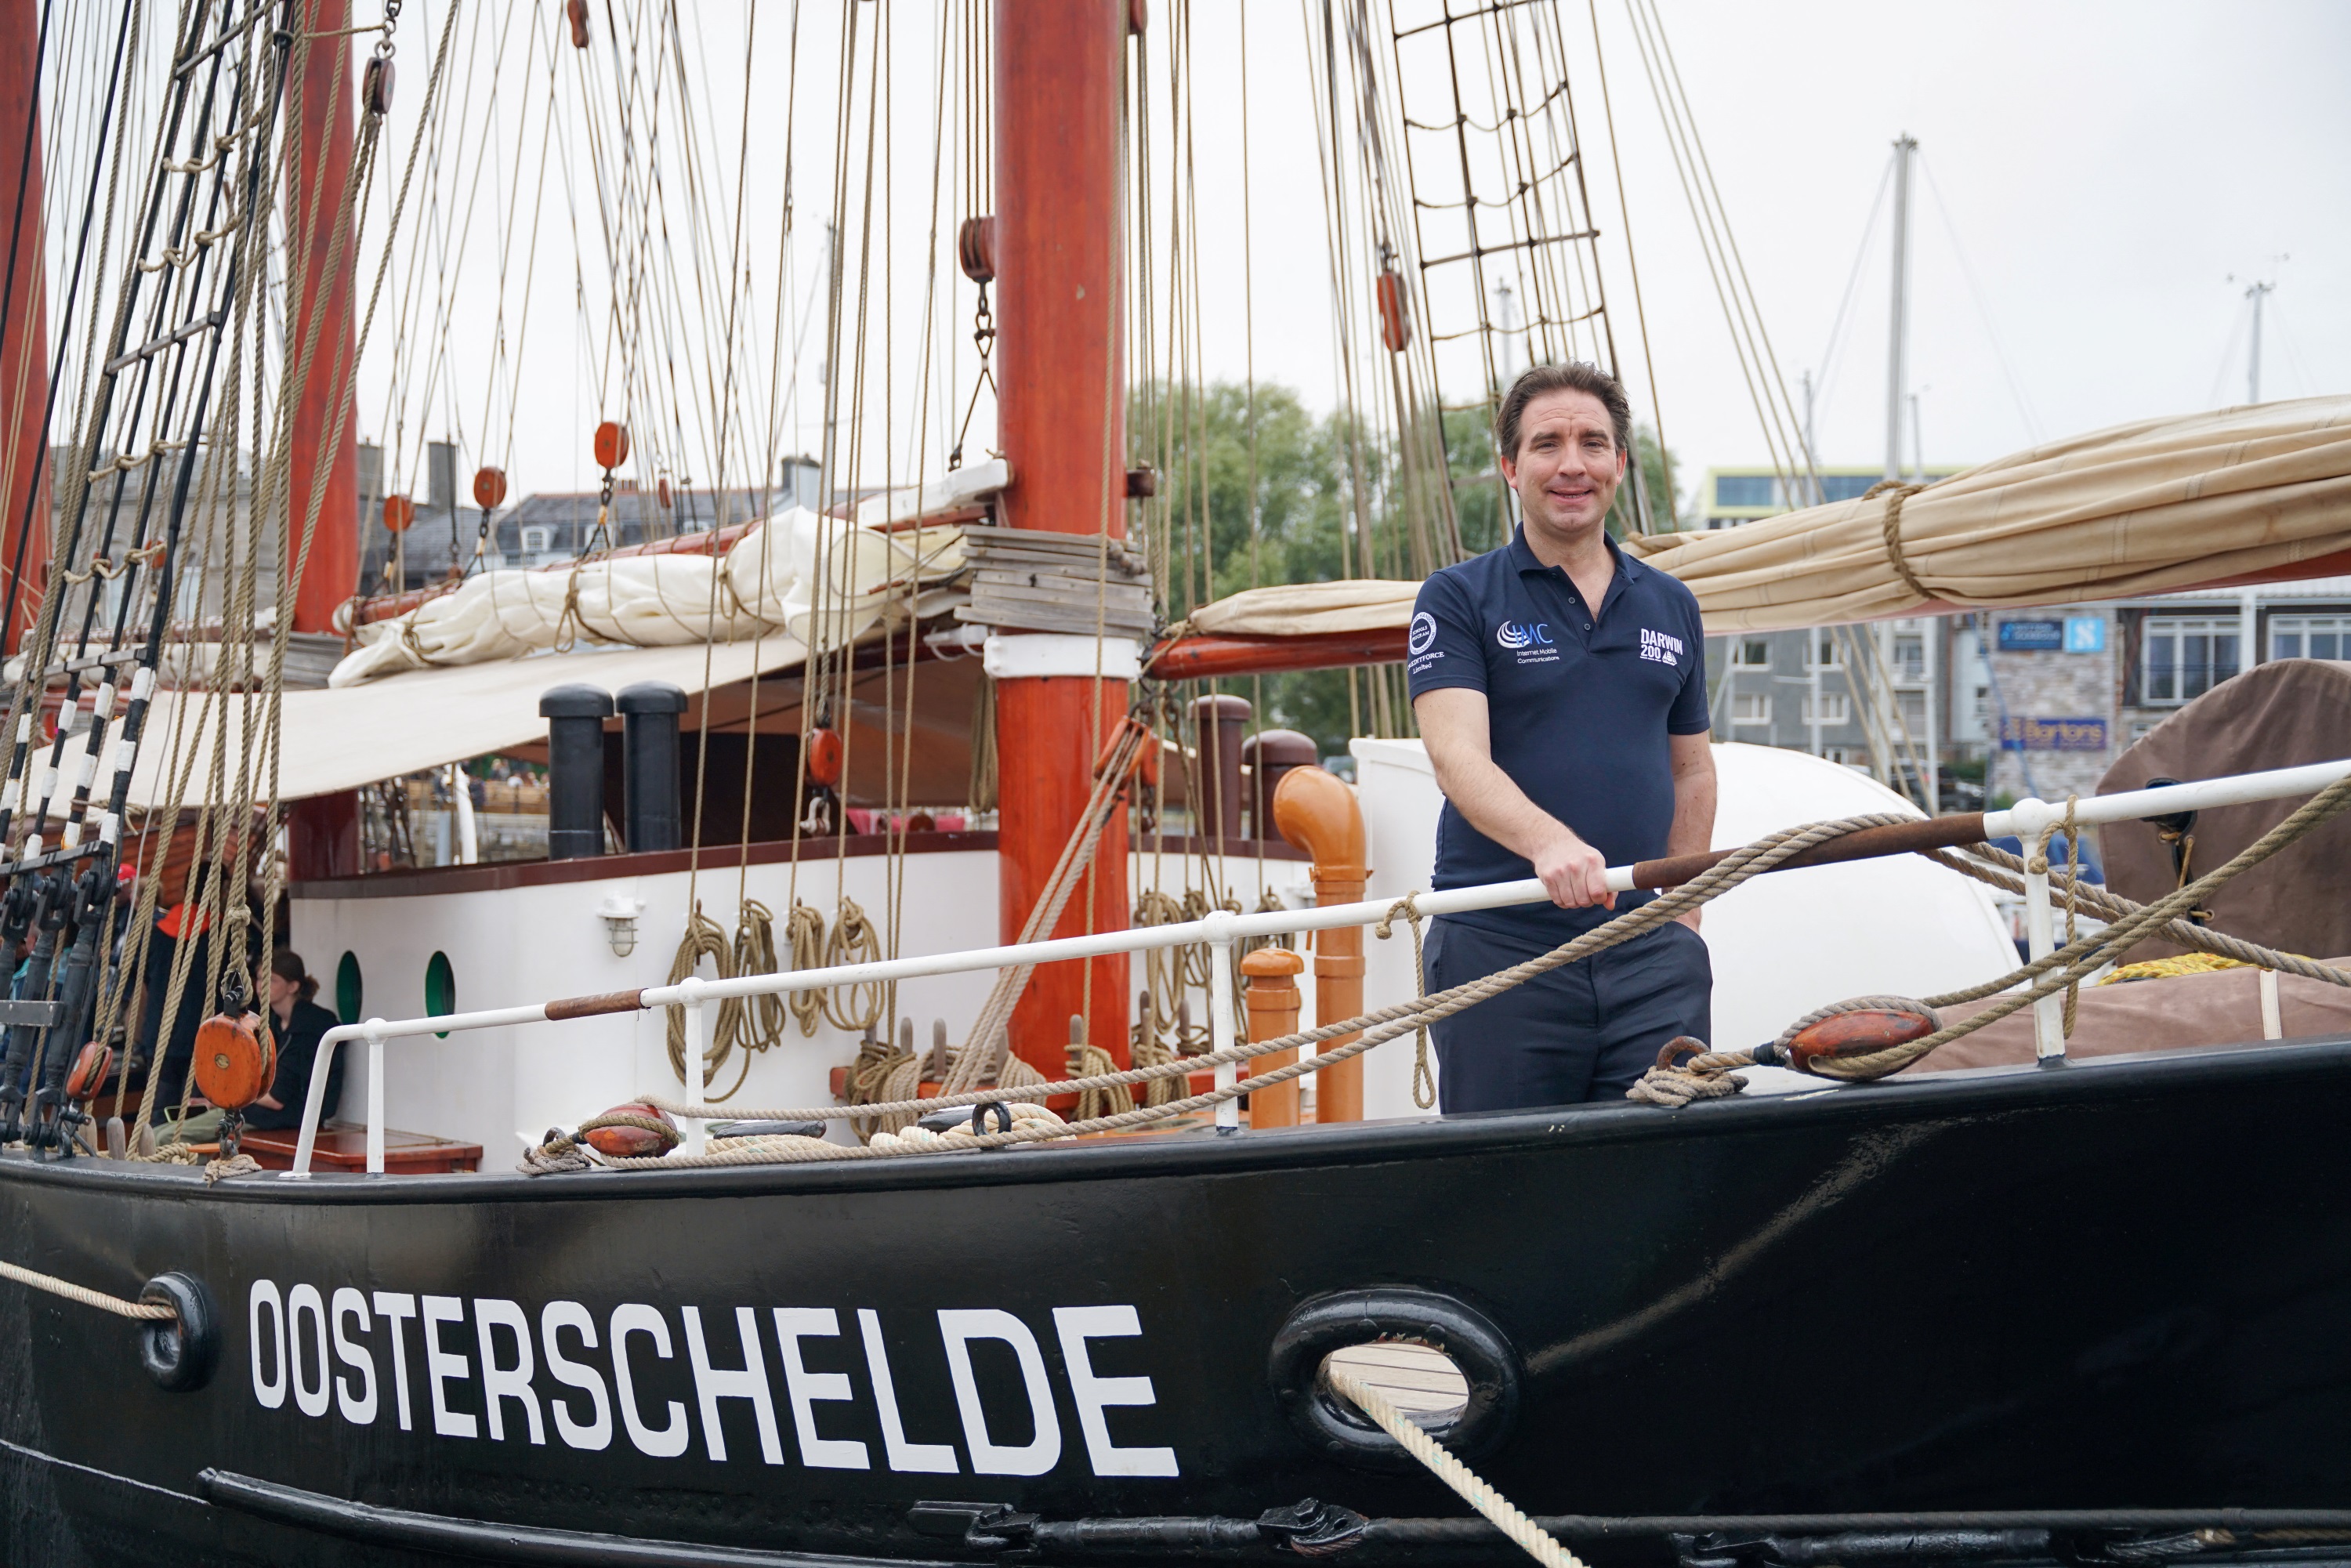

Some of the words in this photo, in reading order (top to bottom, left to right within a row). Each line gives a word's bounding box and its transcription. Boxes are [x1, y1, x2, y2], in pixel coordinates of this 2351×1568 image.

[1512, 624, 1553, 646] IMC
[1640, 628, 1683, 655] DARWIN
[1640, 644, 1661, 659] 200
[1413, 661, 1433, 675] Limited
[249, 1278, 1179, 1478] OOSTERSCHELDE
